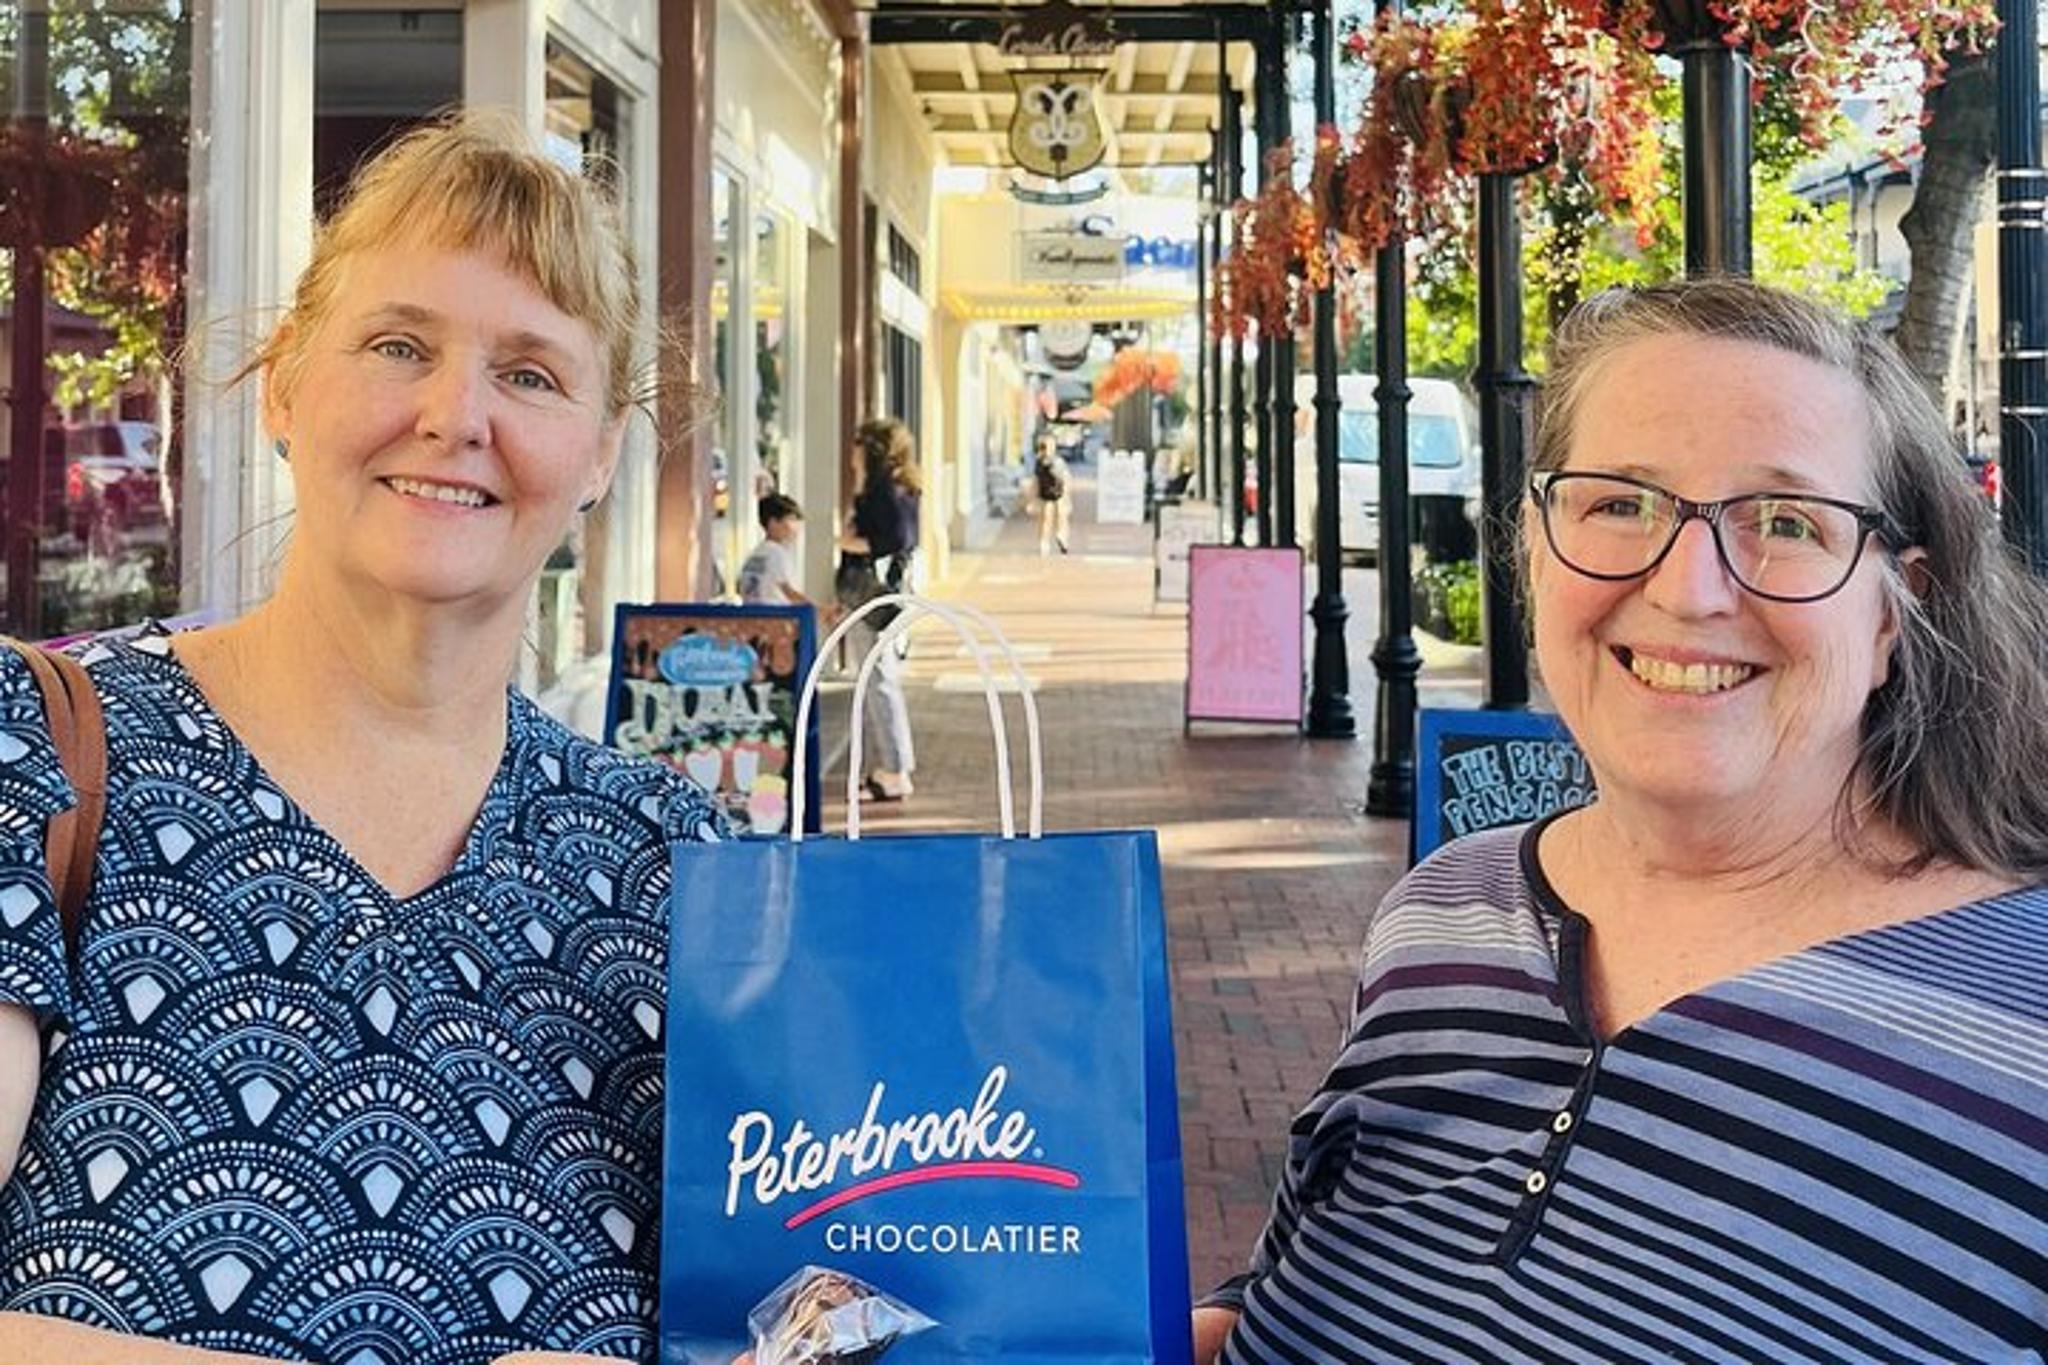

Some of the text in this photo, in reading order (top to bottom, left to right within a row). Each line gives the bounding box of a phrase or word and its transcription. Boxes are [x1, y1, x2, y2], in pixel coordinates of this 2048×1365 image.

[1442, 741, 1586, 796] THE BEST
[725, 1065, 1036, 1216] Peterbrooke
[826, 1223, 1081, 1253] CHOCOLATIER
